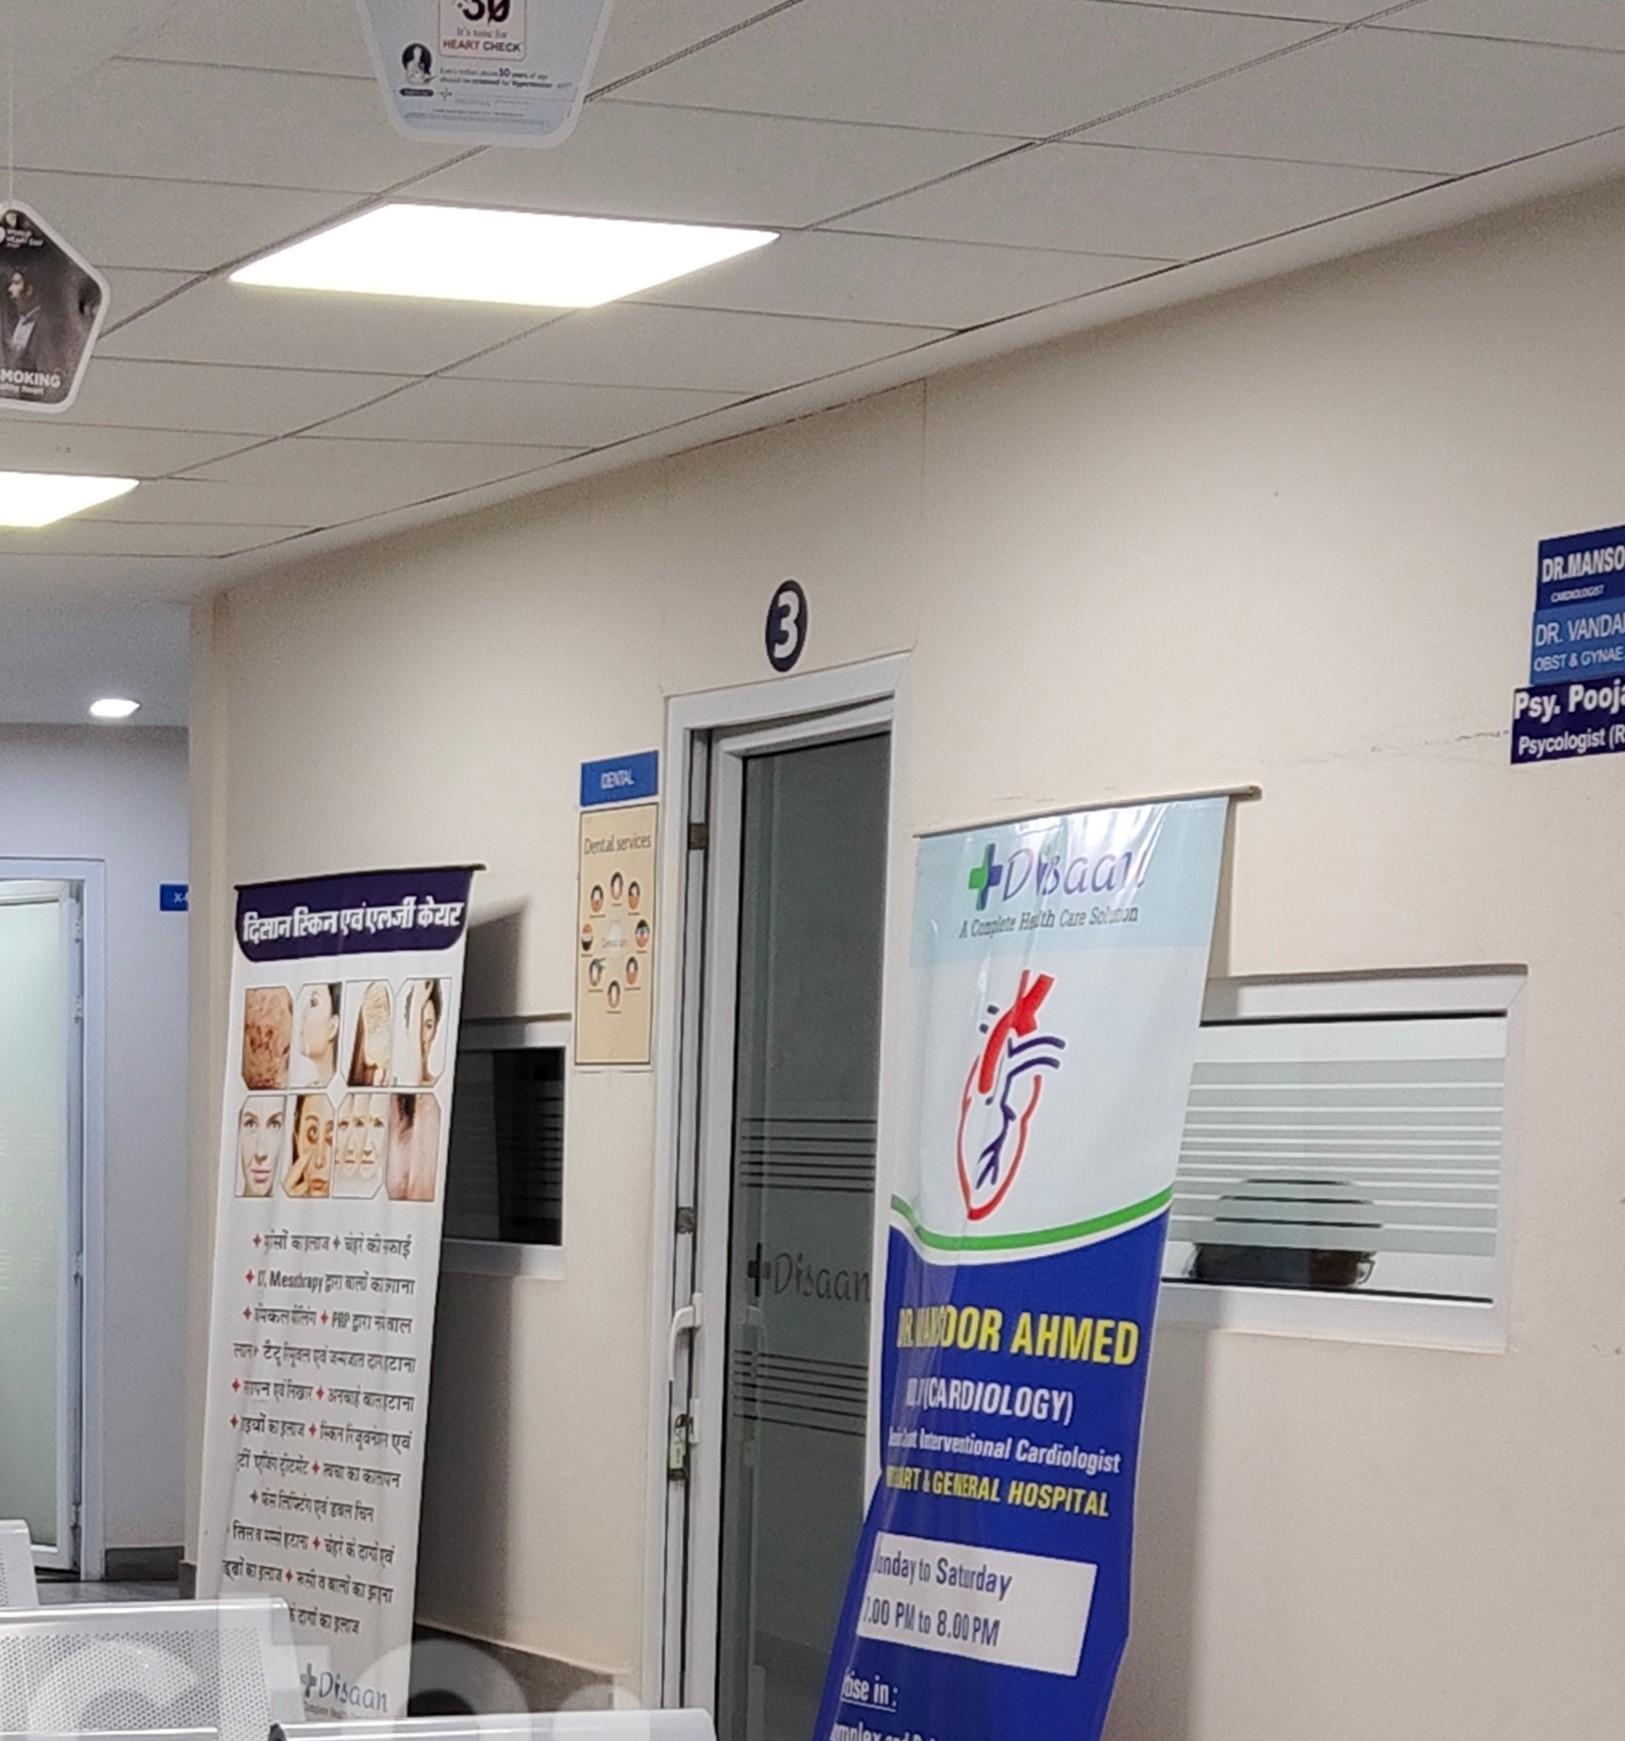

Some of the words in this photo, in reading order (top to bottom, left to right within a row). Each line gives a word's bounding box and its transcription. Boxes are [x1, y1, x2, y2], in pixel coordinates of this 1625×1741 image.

[443, 40, 480, 49] HEART
[483, 42, 521, 52] CHECK
[498, 68, 511, 78] 30
[773, 590, 800, 659] 3
[1535, 623, 1563, 647] DR.
[1534, 653, 1567, 672] OBST
[1569, 654, 1578, 668] &
[1514, 691, 1561, 723] Psy.
[1519, 728, 1605, 758] Psycologist
[601, 769, 634, 789] DENTAL
[243, 911, 292, 944] दिसान
[292, 906, 340, 937] स्किन
[340, 901, 366, 936] एवं
[417, 896, 465, 928] केयर
[959, 921, 968, 939] A
[971, 917, 1016, 939] Complete
[1018, 910, 1055, 931] Health
[1059, 908, 1087, 928] Care
[773, 1253, 871, 1301] Disaan
[1010, 1312, 1139, 1366] AHMED
[391, 1430, 413, 1454] एवं
[1016, 1438, 1122, 1476] Cardiologist
[933, 1470, 1001, 1503] GENERAL
[1008, 1480, 1110, 1518] HOSPITAL
[919, 1558, 931, 1582] to
[936, 1557, 1012, 1601] Saturday
[895, 1601, 915, 1630] PM
[919, 1610, 931, 1634] to
[937, 1609, 969, 1641] 8.00
[972, 1616, 1001, 1647] PM
[319, 1671, 387, 1713] Disaan
[873, 1675, 889, 1705] in
